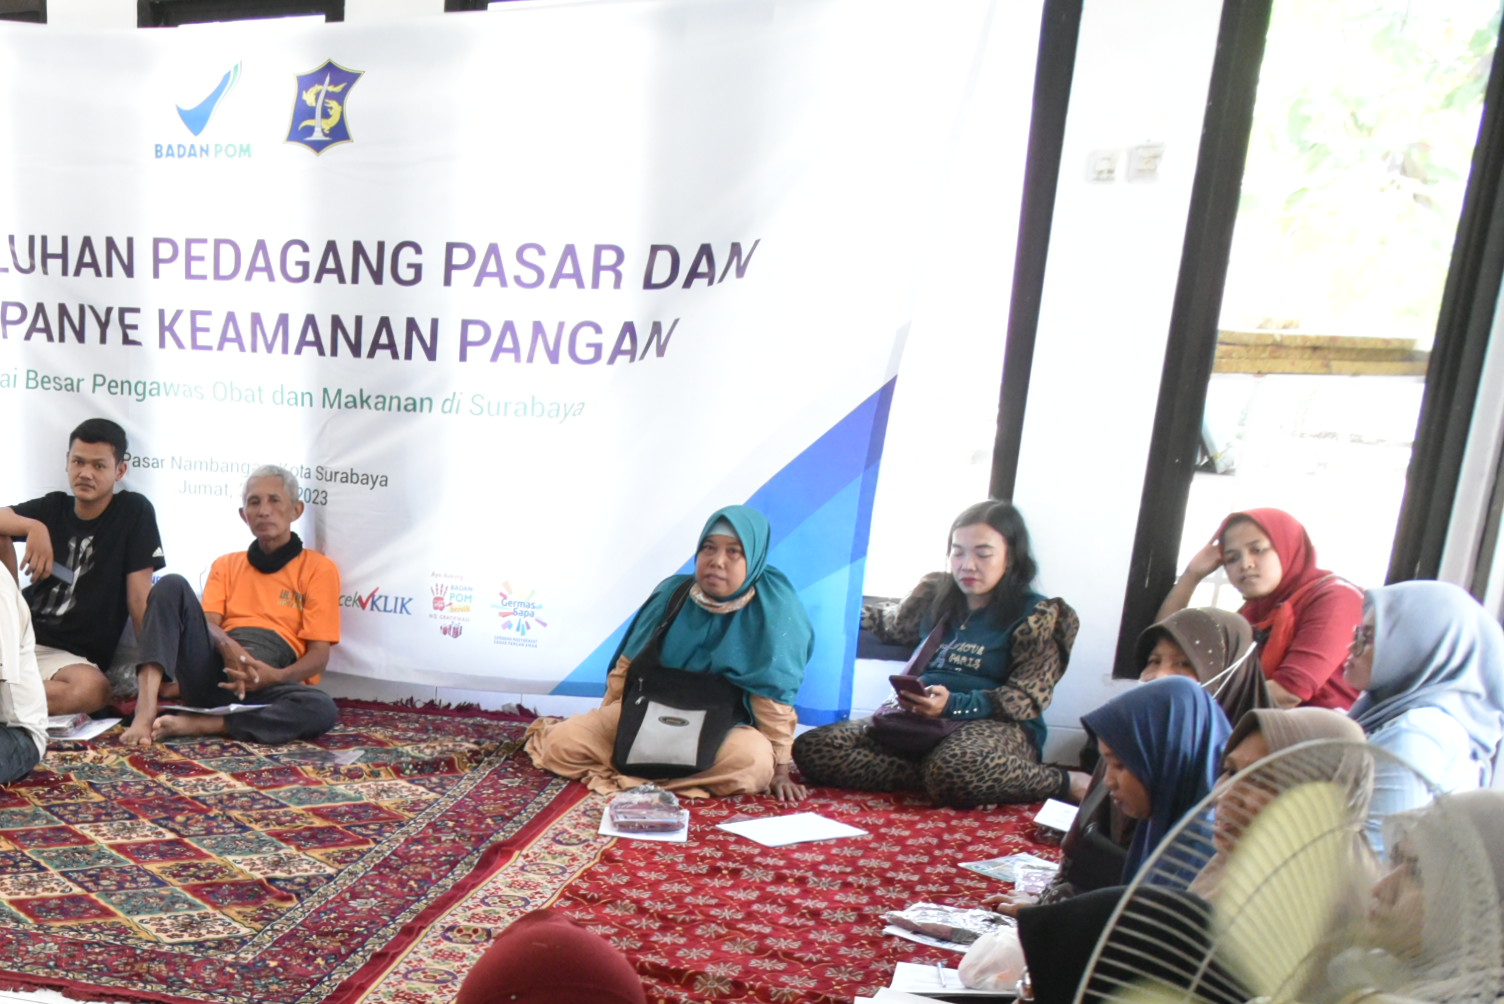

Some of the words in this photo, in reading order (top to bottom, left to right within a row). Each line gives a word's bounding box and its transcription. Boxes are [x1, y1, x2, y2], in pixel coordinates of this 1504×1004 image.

[154, 143, 209, 159] BADAN
[214, 143, 252, 159] POM
[152, 237, 424, 286] PEDAGANG
[442, 240, 626, 290] PASAR
[642, 238, 761, 290] DAN
[157, 308, 439, 362] KEAMANAN
[458, 317, 681, 366] PANGAN
[25, 369, 85, 393] Besar
[91, 373, 204, 402] Pengawas
[212, 380, 264, 405] Obat
[272, 385, 314, 409] dan
[321, 387, 434, 414] Makanan
[440, 391, 462, 415] di
[469, 393, 586, 424] Surabaya
[123, 452, 165, 469] Pasar
[316, 465, 389, 490] Surabaya
[178, 479, 232, 500] Jumat,
[449, 592, 473, 603] POM
[501, 597, 536, 610] Germas
